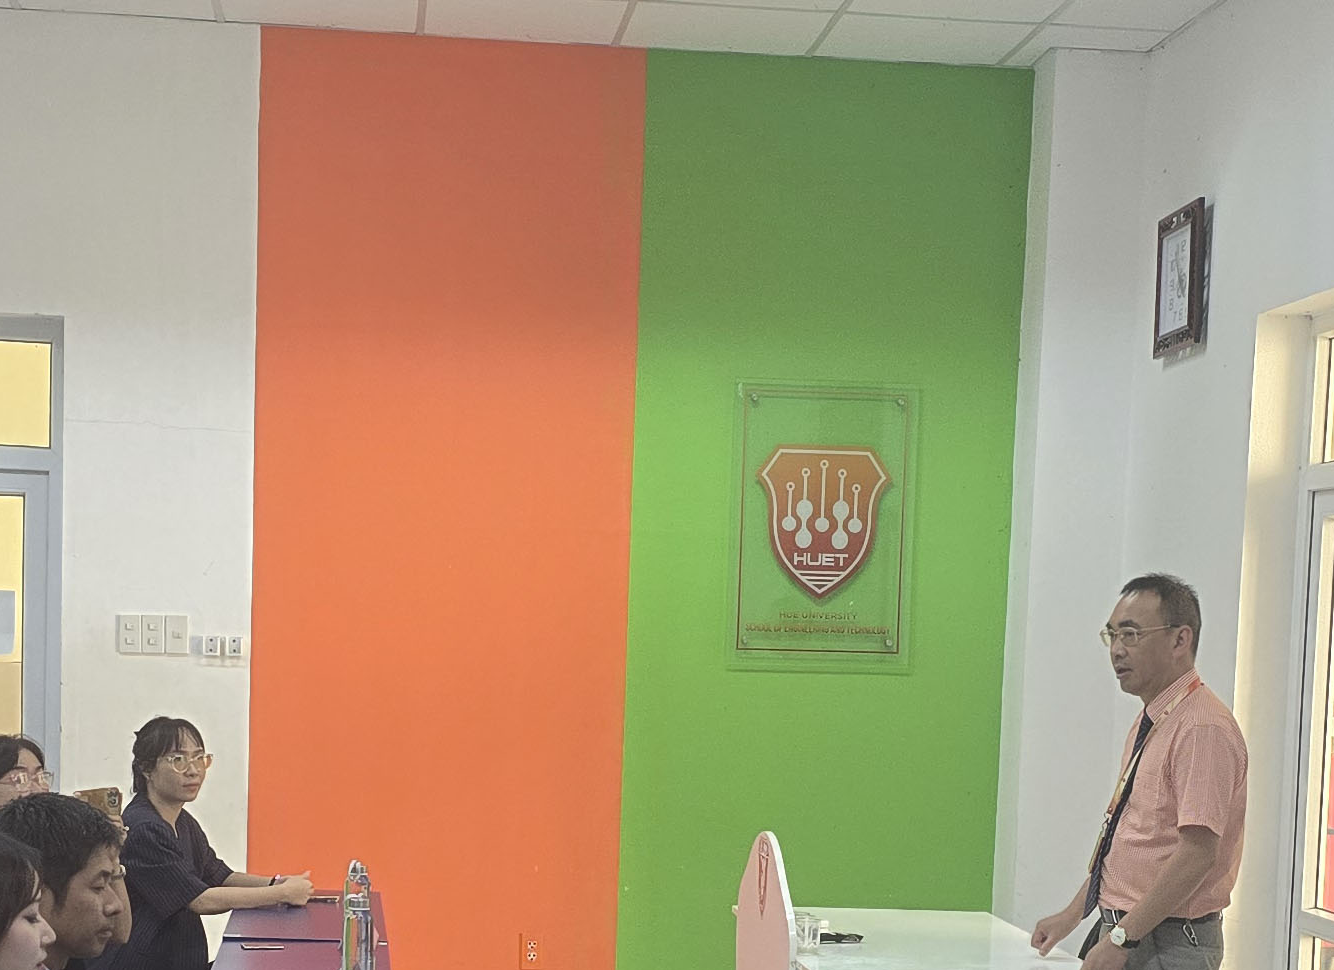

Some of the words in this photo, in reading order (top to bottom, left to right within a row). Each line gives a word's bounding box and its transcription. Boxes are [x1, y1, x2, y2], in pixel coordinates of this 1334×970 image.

[793, 552, 849, 567] HUET
[779, 610, 799, 620] HUE
[802, 610, 858, 621] UNIVERSITY
